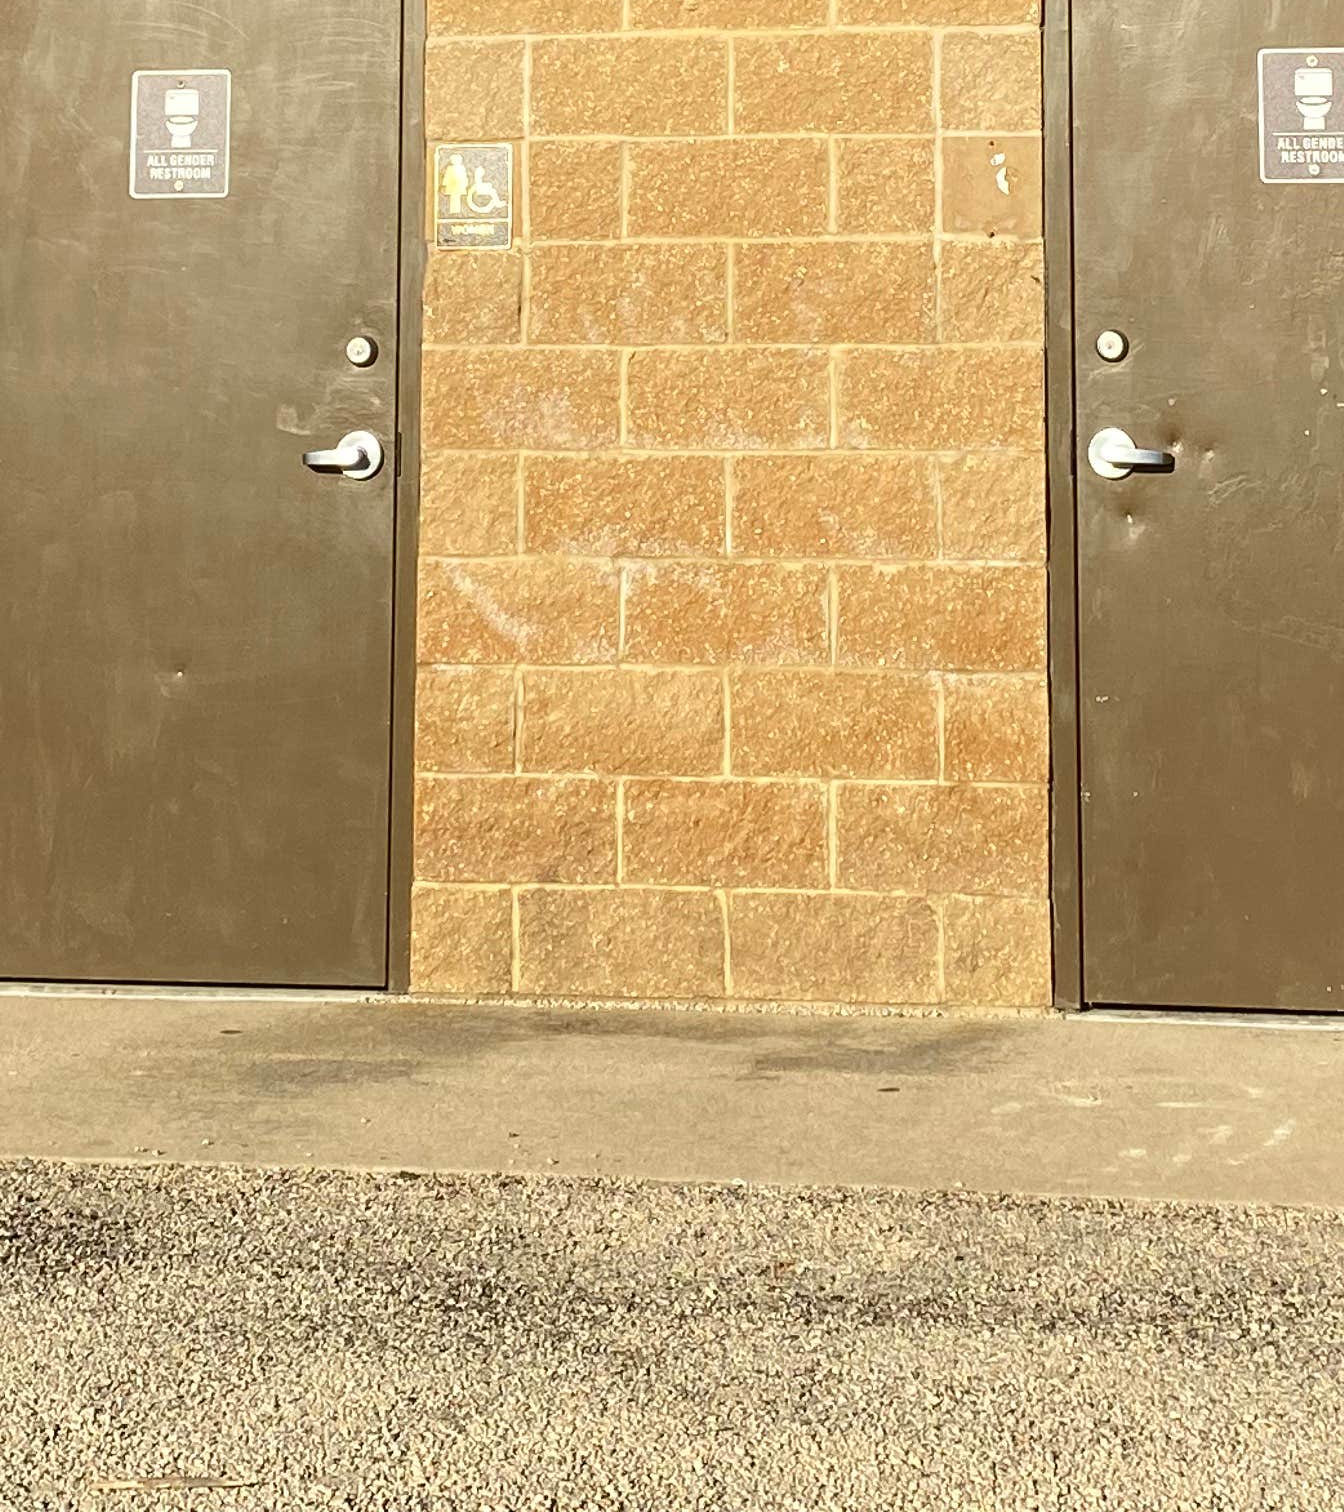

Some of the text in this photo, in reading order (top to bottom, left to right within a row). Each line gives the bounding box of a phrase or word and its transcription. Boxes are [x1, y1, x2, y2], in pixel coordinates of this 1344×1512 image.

[1277, 137, 1301, 150] ALL
[146, 154, 215, 167] ALL GENDER
[149, 167, 211, 180] RESTROOM
